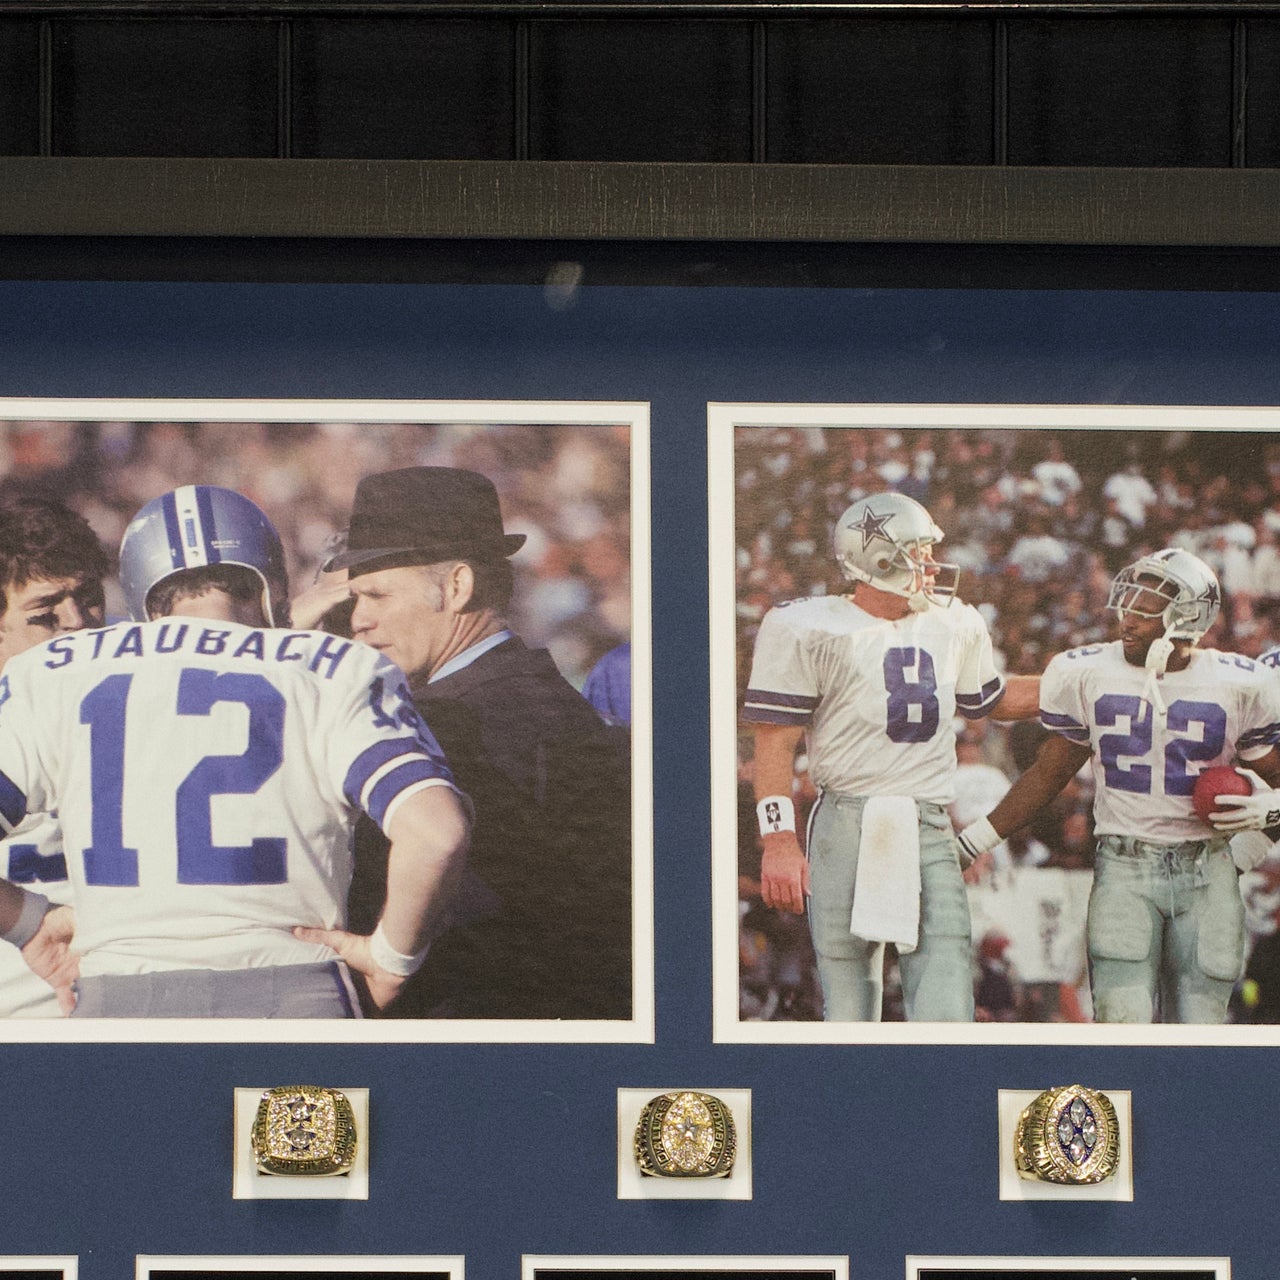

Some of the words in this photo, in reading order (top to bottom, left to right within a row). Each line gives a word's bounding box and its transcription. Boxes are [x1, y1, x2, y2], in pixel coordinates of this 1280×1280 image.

[45, 623, 354, 680] STAUBACH
[883, 646, 940, 744] 8
[78, 668, 288, 887] 12
[1094, 694, 1227, 795] 22
[654, 1100, 670, 1166] DALLAS
[707, 1101, 724, 1167] COWBOYS
